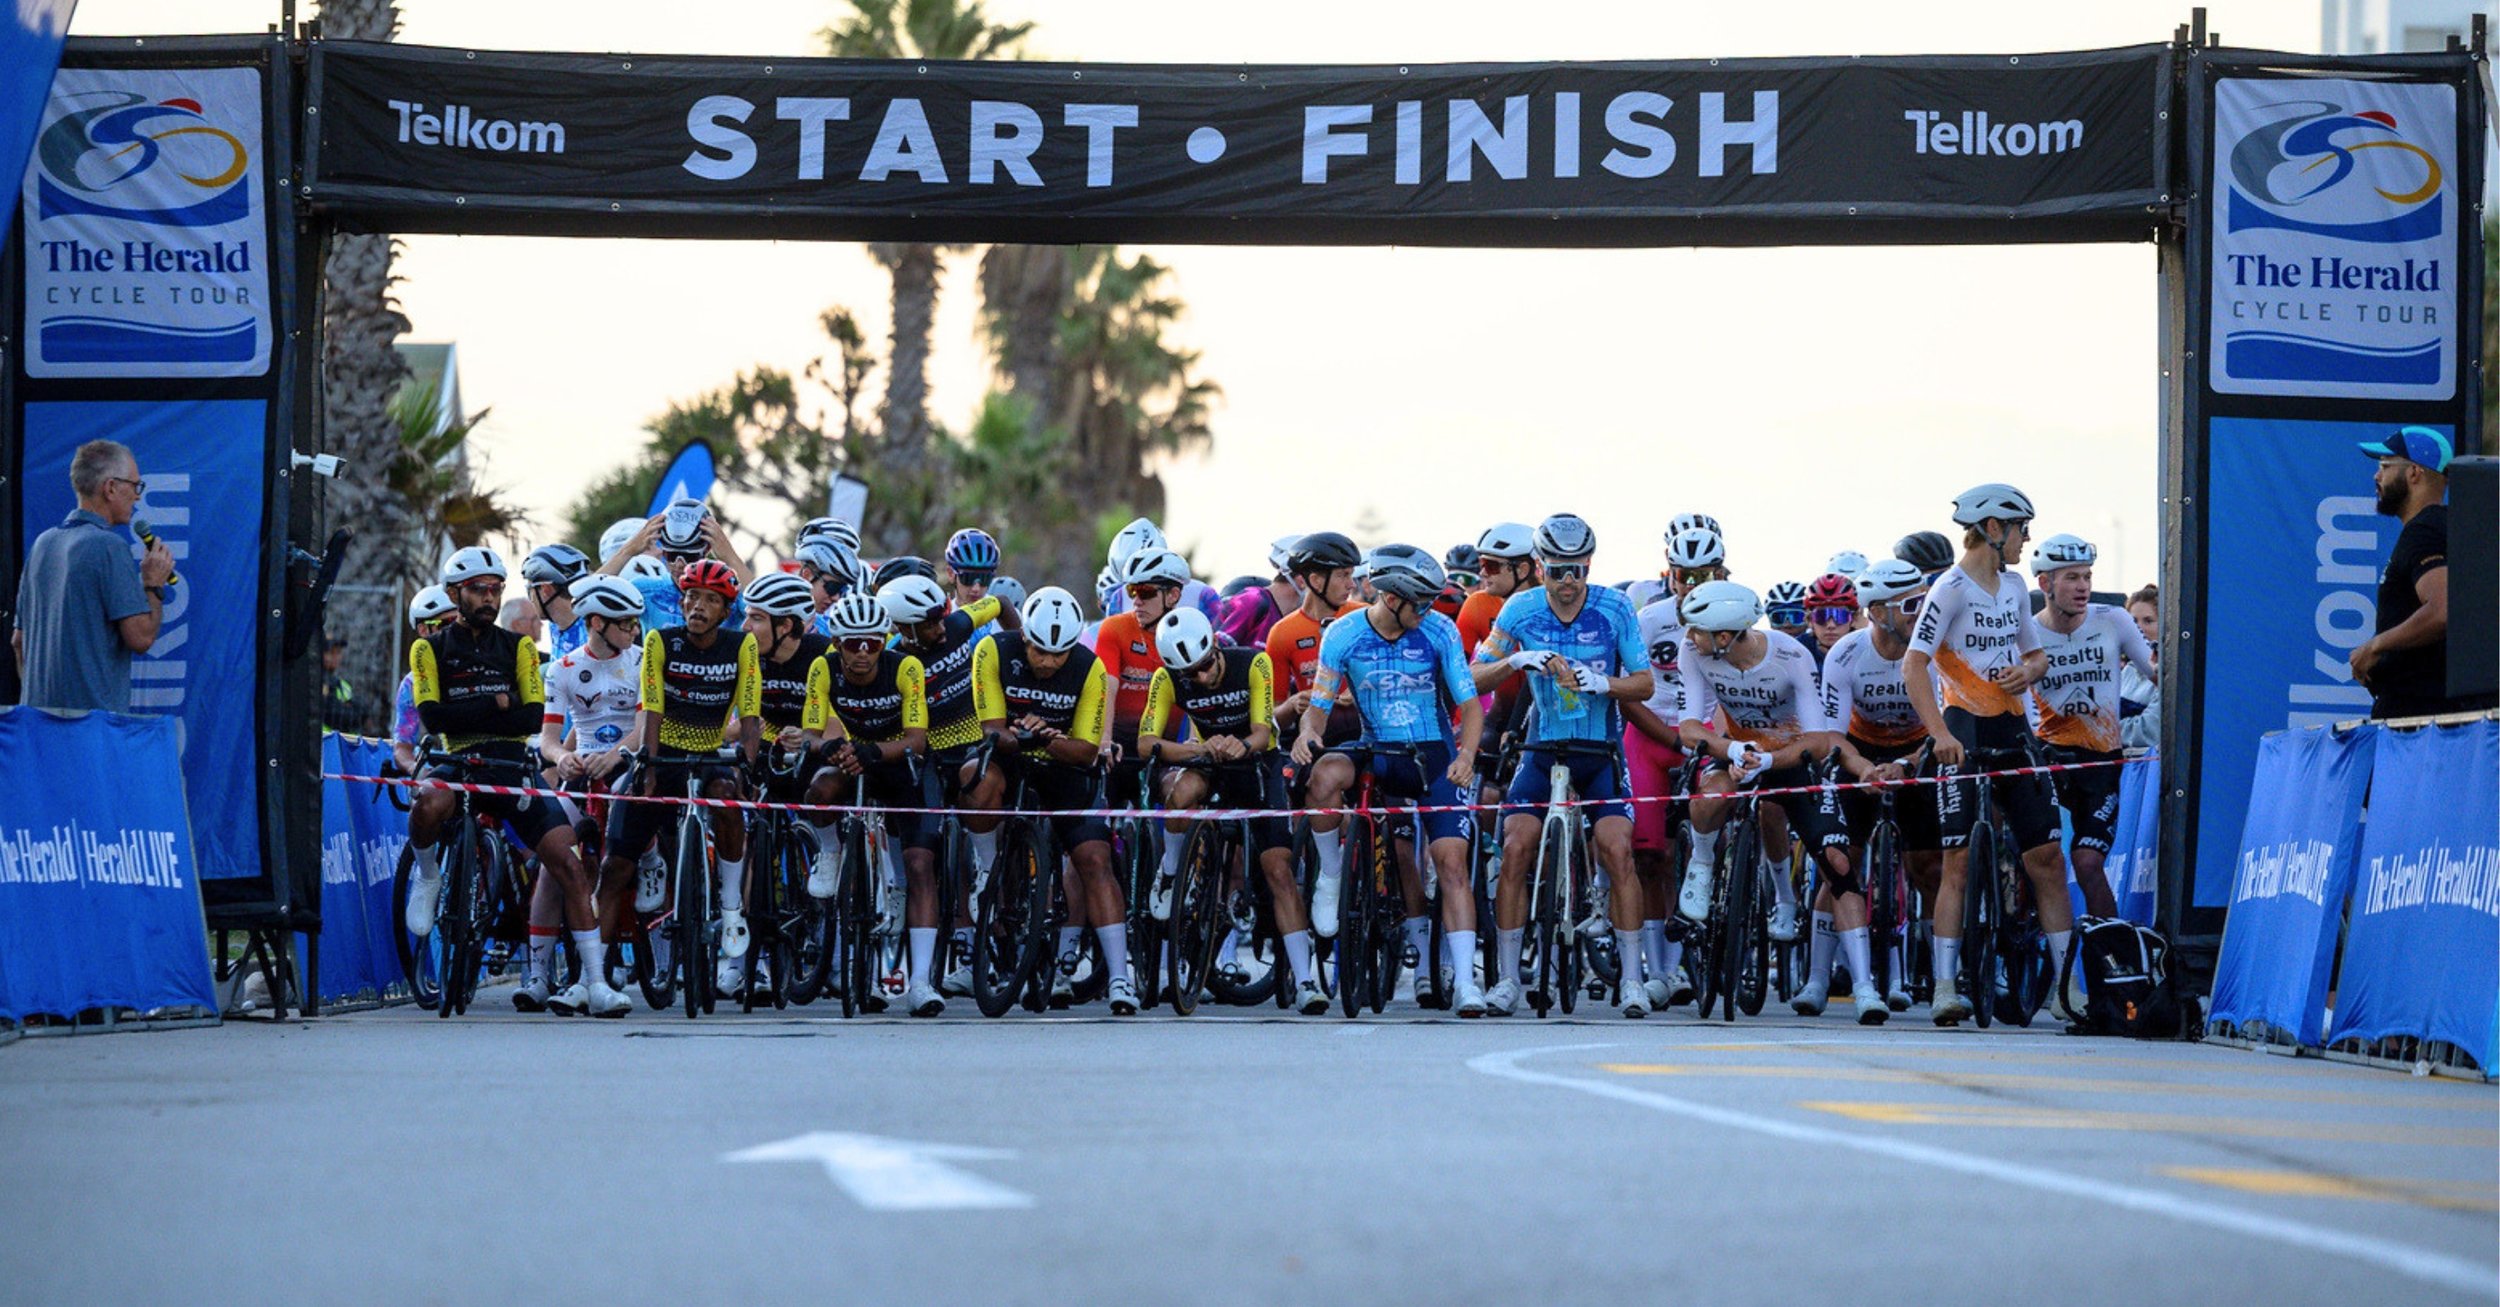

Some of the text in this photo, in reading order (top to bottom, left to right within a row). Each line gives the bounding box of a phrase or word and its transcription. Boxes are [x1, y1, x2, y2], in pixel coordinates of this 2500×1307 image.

[388, 99, 565, 154] Telkom
[1905, 109, 2084, 156] Telkom
[682, 90, 1779, 187] START FINISH
[40, 240, 251, 273] The Herald
[2227, 254, 2440, 292] The Herald
[47, 287, 250, 304] CYCLE TOUR
[2233, 301, 2437, 324] CYCLE TOUR
[1918, 600, 1941, 645] RH77
[2288, 496, 2378, 728] lkom
[1965, 633, 2017, 652] Dynam
[668, 661, 738, 676] CROWN
[2047, 646, 2104, 668] Realty
[761, 679, 808, 691] CROW
[2041, 666, 2112, 690] Dynamix
[1006, 686, 1077, 703] CROWN
[1186, 689, 1251, 709] CROWN
[1714, 683, 1778, 701] Realty
[1824, 681, 1840, 719] RH77
[1863, 683, 1907, 698] Realt
[1041, 701, 1076, 710] CYCLES
[0, 825, 21, 882] he
[16, 825, 78, 884] Herald
[2364, 855, 2389, 915] The
[2385, 847, 2433, 911] Herald
